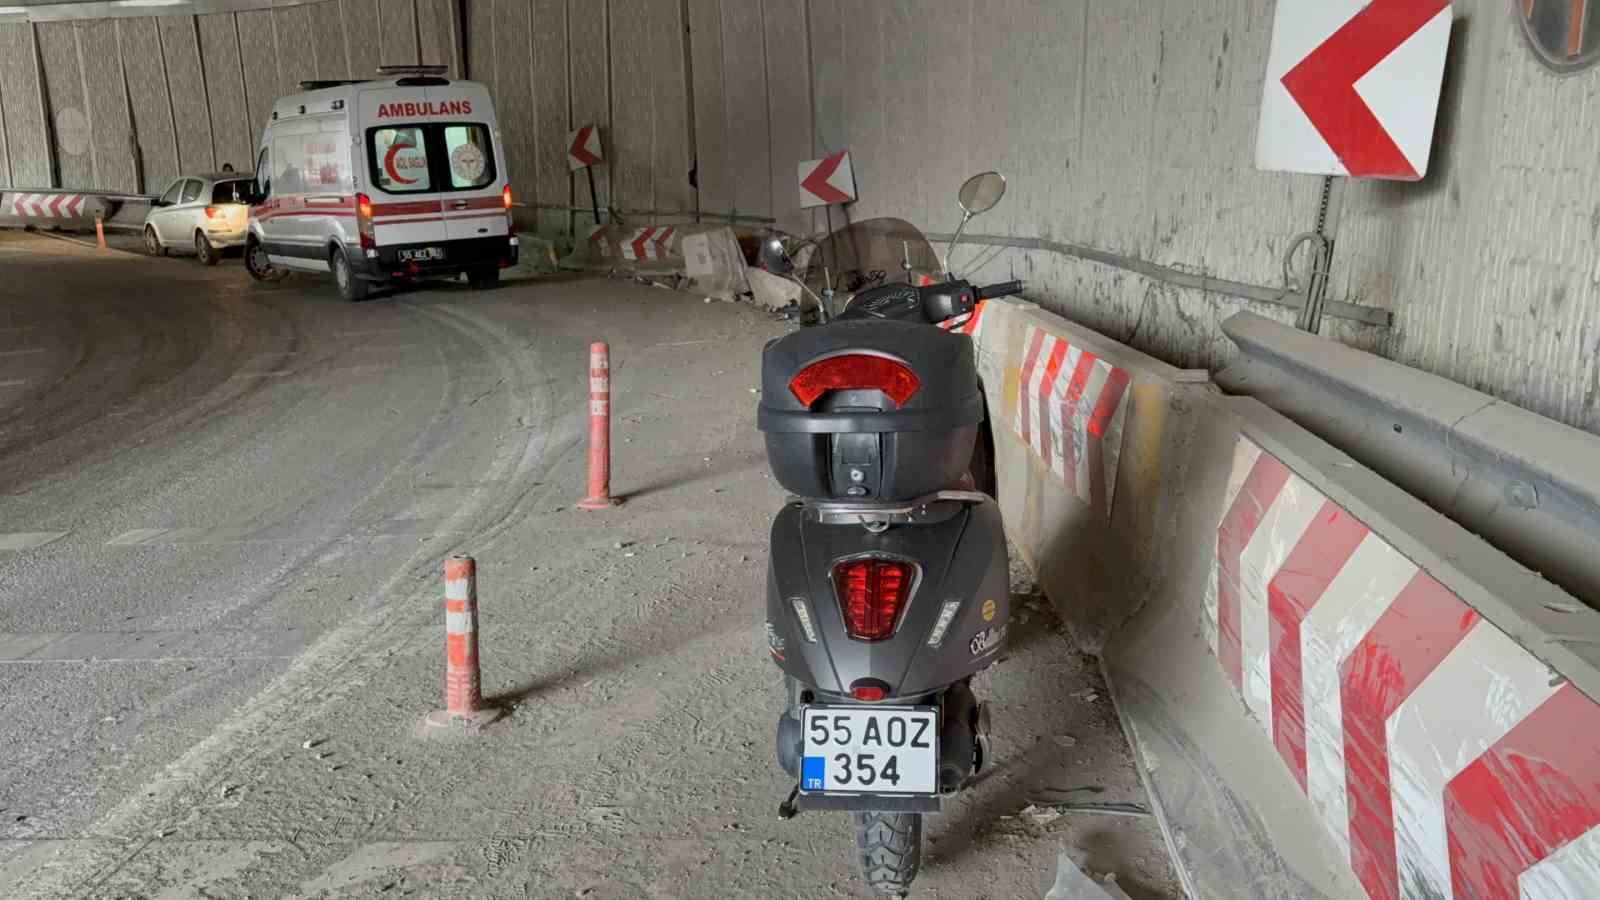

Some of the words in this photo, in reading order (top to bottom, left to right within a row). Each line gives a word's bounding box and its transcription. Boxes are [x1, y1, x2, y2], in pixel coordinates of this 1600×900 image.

[378, 101, 472, 117] AMBULANS
[811, 715, 852, 746] 55
[862, 716, 930, 748] AOZ
[833, 753, 900, 786] 354
[807, 778, 822, 789] TR
